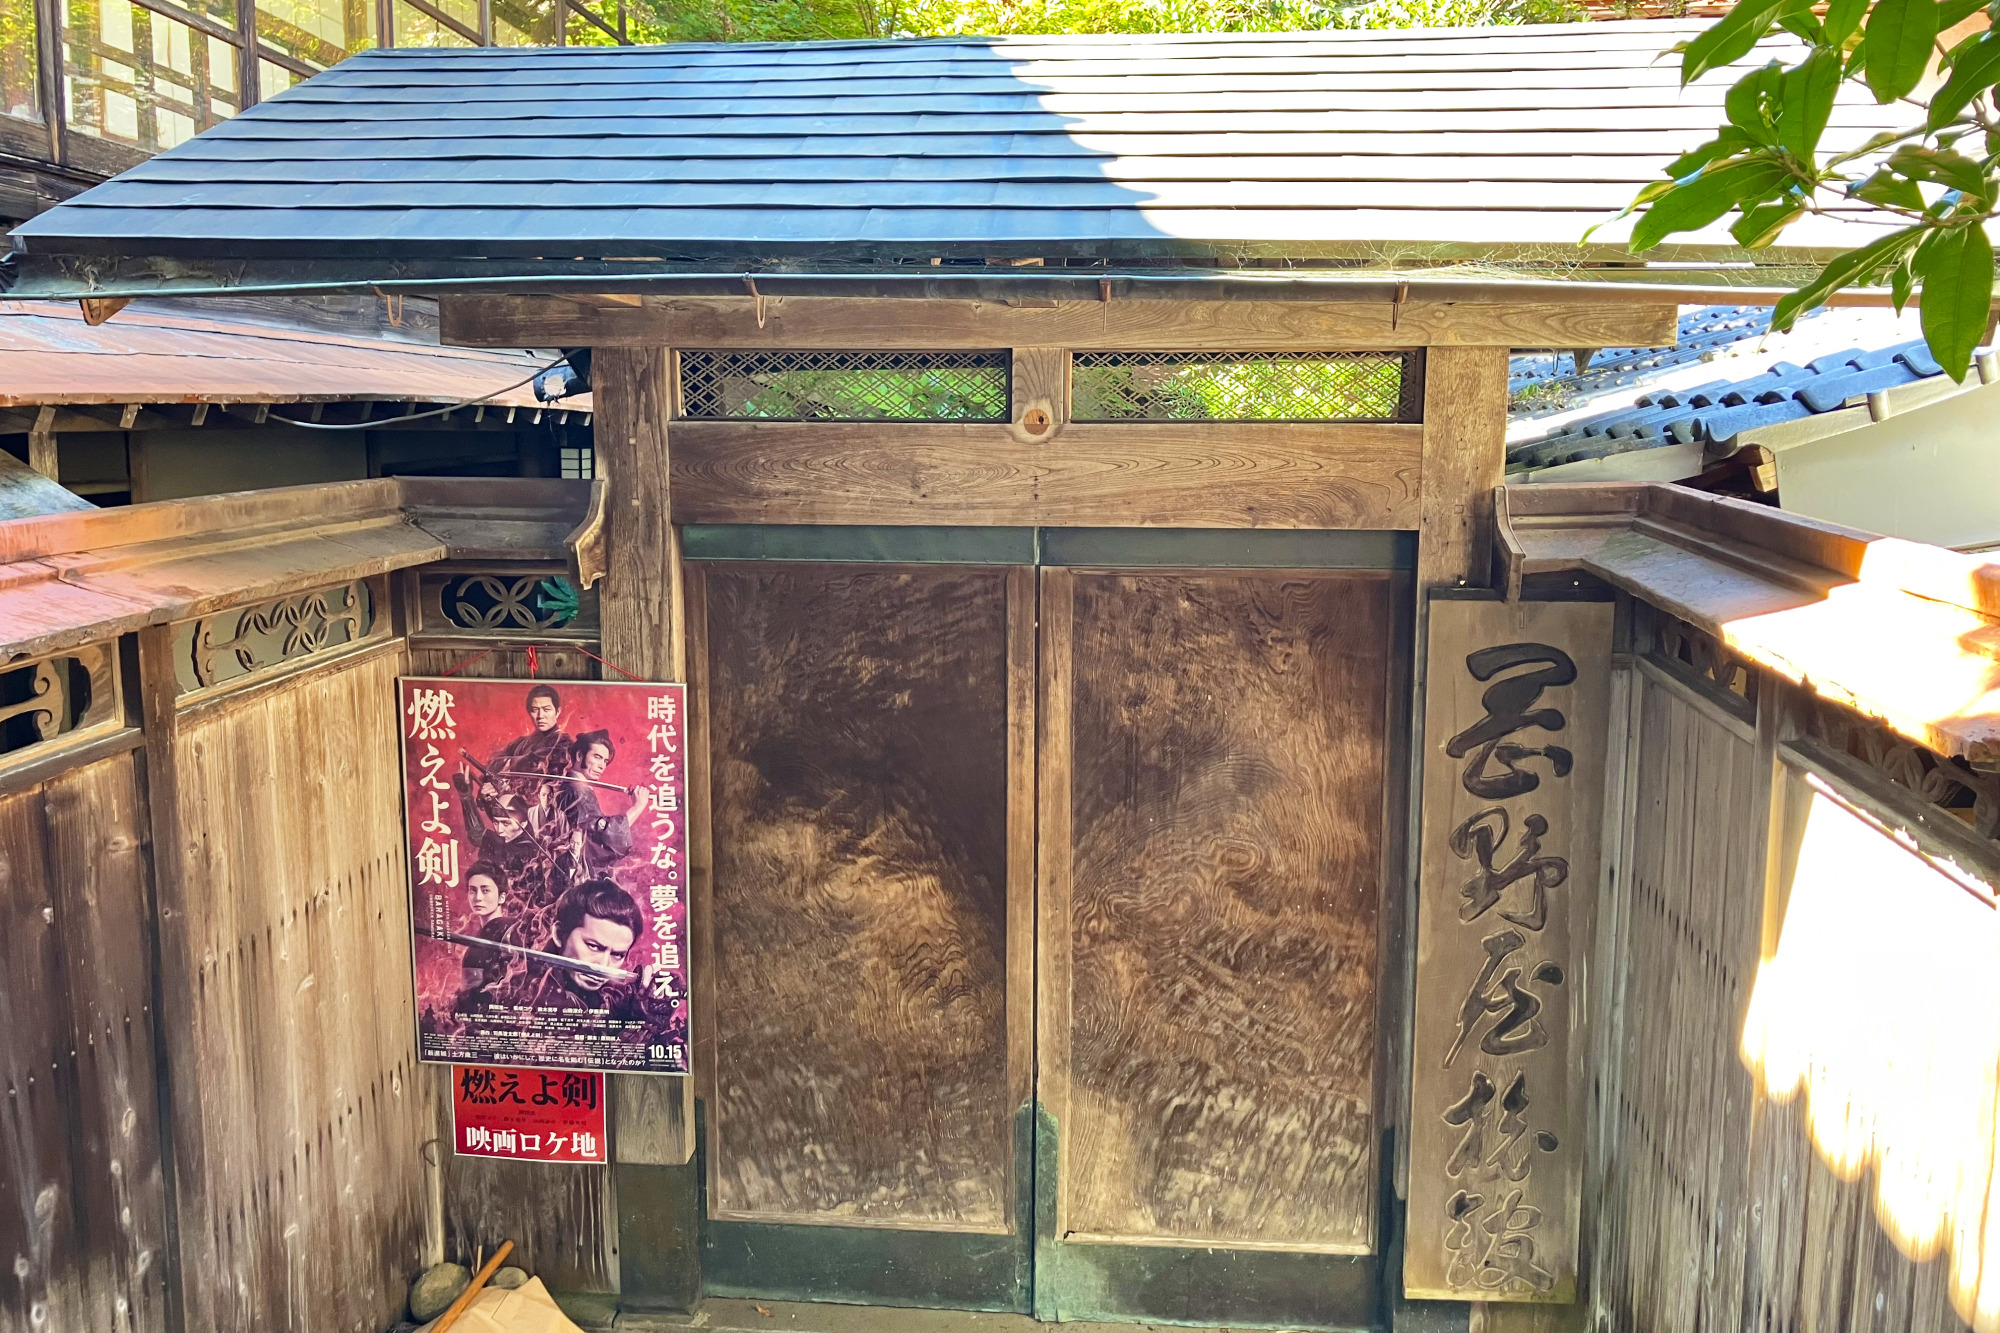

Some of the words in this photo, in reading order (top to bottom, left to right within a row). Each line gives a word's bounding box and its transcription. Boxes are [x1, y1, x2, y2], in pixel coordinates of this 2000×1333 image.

[407, 688, 460, 888] 燃えよ剣
[646, 695, 681, 1010] 時代を追うな。夢を追え。
[434, 894, 444, 941] BARAGAKI
[648, 1044, 682, 1060] 10.15
[461, 1067, 597, 1110] 燃えよ剣
[466, 1126, 597, 1157] 映画ロケ地
